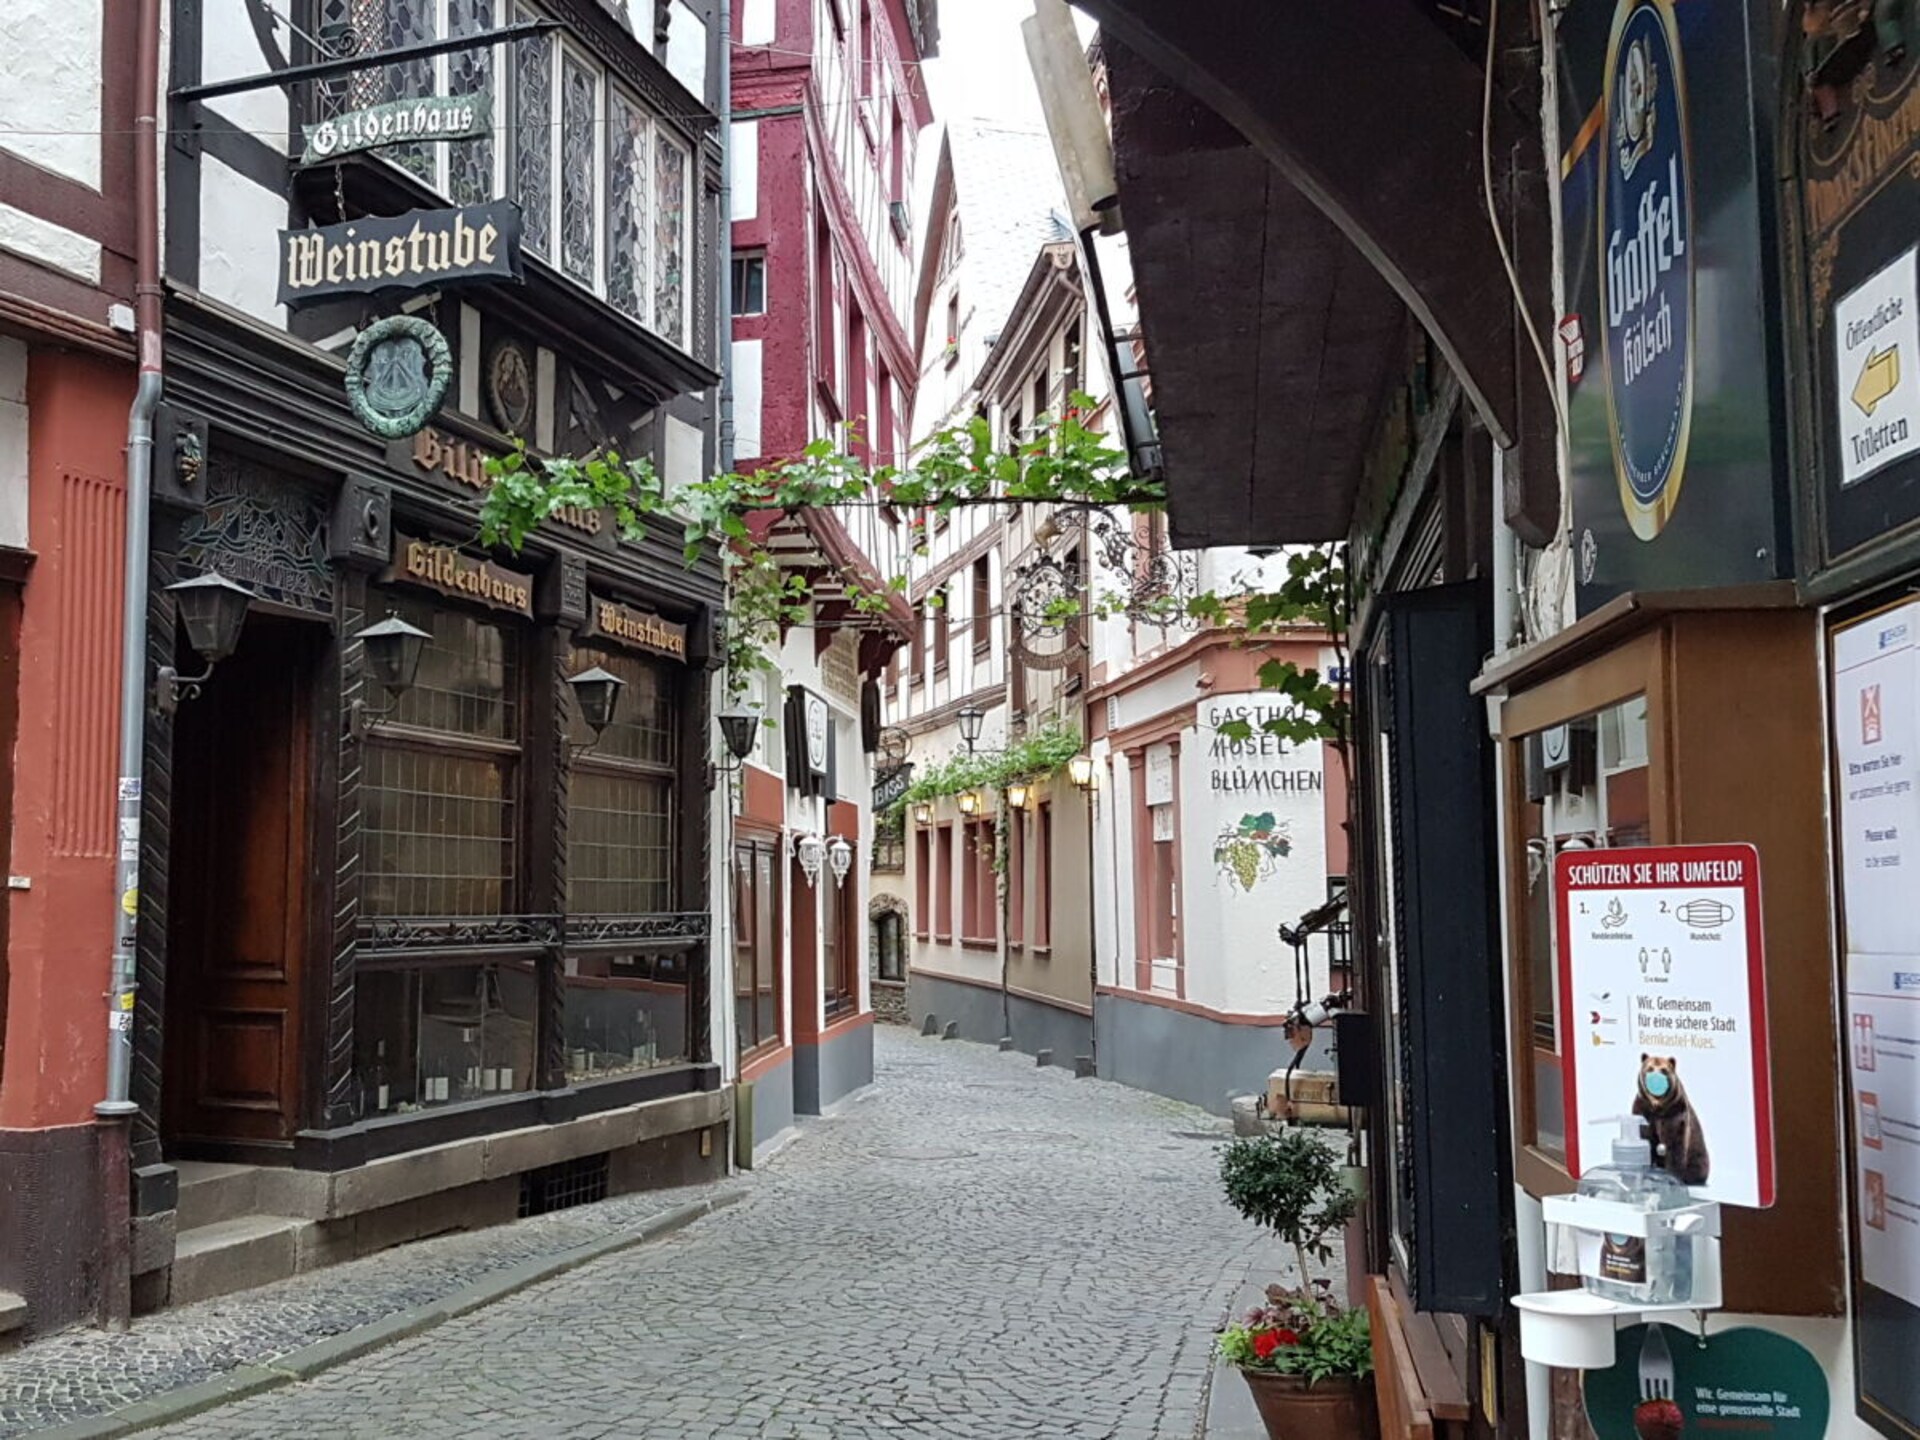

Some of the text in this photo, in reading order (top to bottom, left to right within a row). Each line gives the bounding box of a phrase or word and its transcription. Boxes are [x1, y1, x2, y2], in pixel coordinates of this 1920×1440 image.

[313, 102, 474, 155] Gildenhaus
[288, 212, 499, 289] Weinstube
[1608, 150, 1685, 328] Gaffel
[1623, 289, 1672, 386] Kölsch
[1850, 417, 1909, 465] Toiletten
[407, 542, 527, 609] Gildenhaus
[600, 602, 684, 652] Weinstuben
[1210, 765, 1322, 792] BLÜMCHEN
[1568, 860, 1743, 885] SCHÜTZEN SIE IHR UMFELD!
[1579, 902, 1590, 914] 1.
[1659, 901, 1671, 913] 2.
[1637, 995, 1711, 1012] Wir. Gemeinsam
[1638, 1014, 1736, 1032] für eine sichere Stadt
